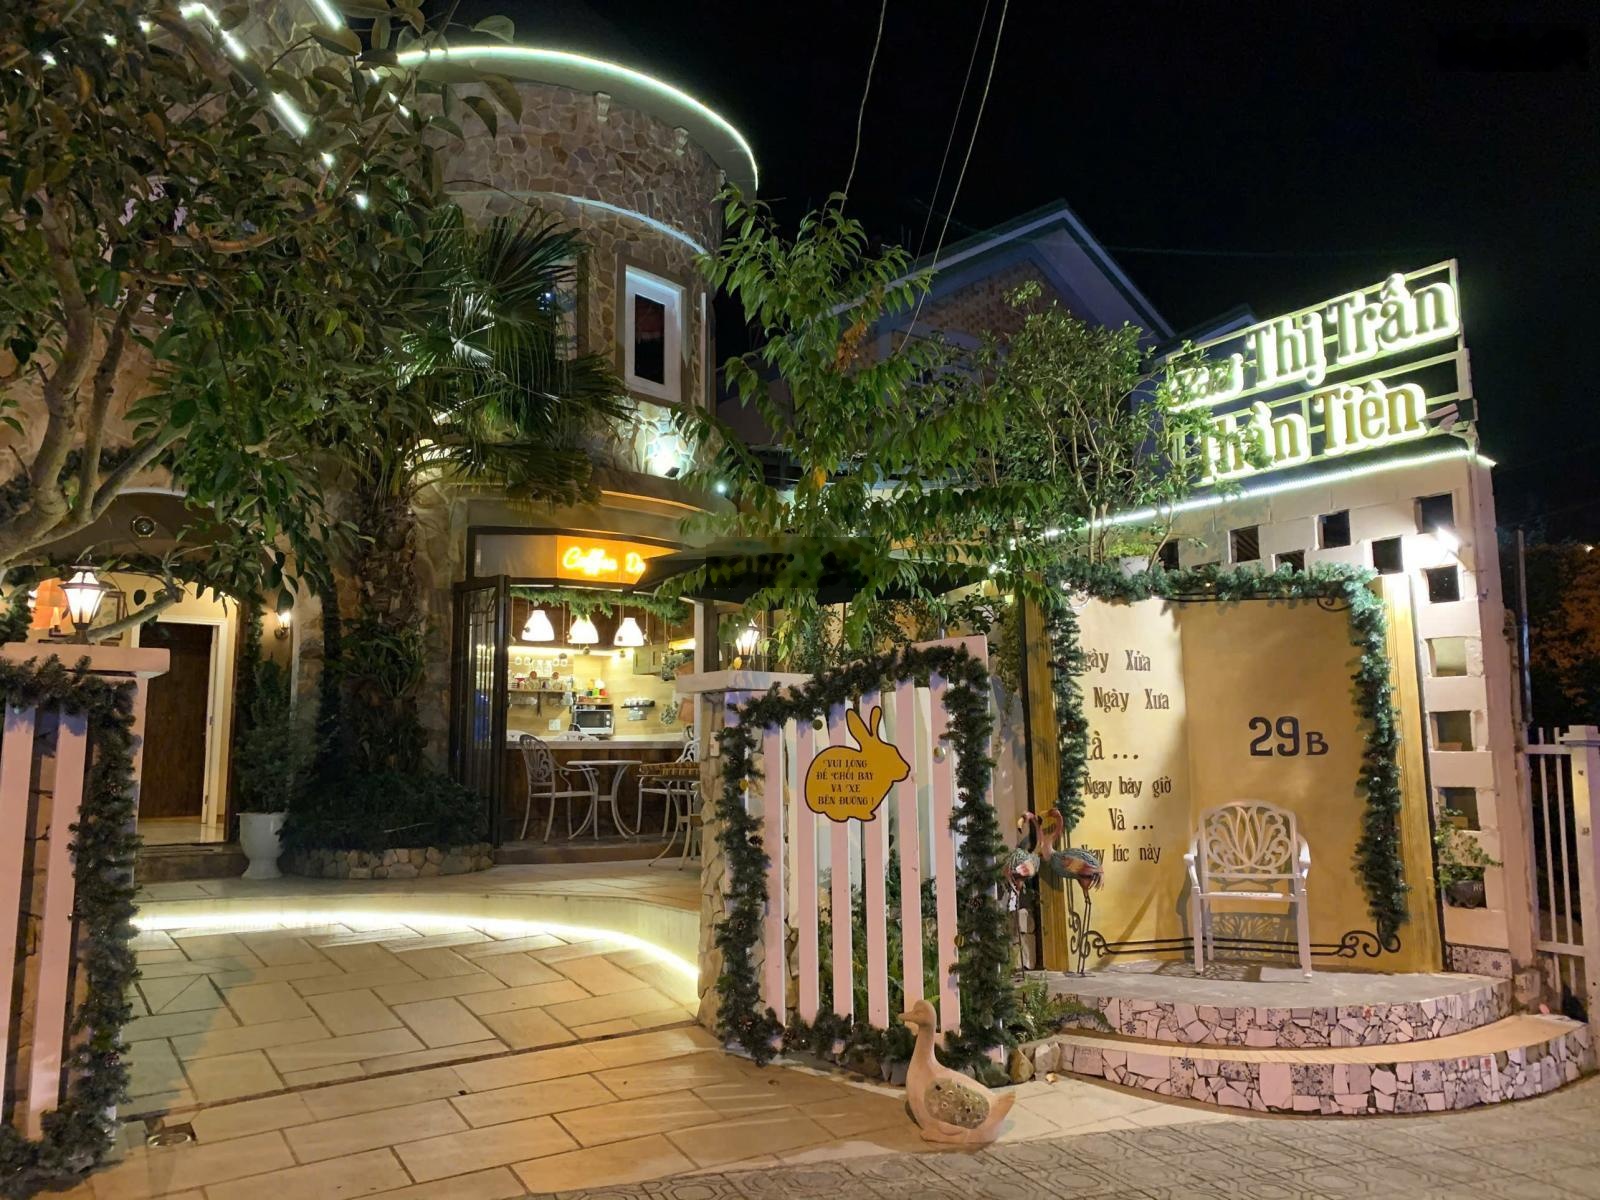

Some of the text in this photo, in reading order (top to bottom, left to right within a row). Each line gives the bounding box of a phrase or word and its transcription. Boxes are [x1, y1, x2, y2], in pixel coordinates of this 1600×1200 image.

[1327, 273, 1459, 366] Trấn
[1313, 380, 1427, 456] Tiên
[1079, 648, 1109, 674] gày
[1093, 686, 1170, 713] Ngày Xưa
[823, 759, 842, 768] VUI
[846, 783, 861, 793] XE
[1108, 807, 1126, 831] Và
[1112, 843, 1130, 862] lúc
